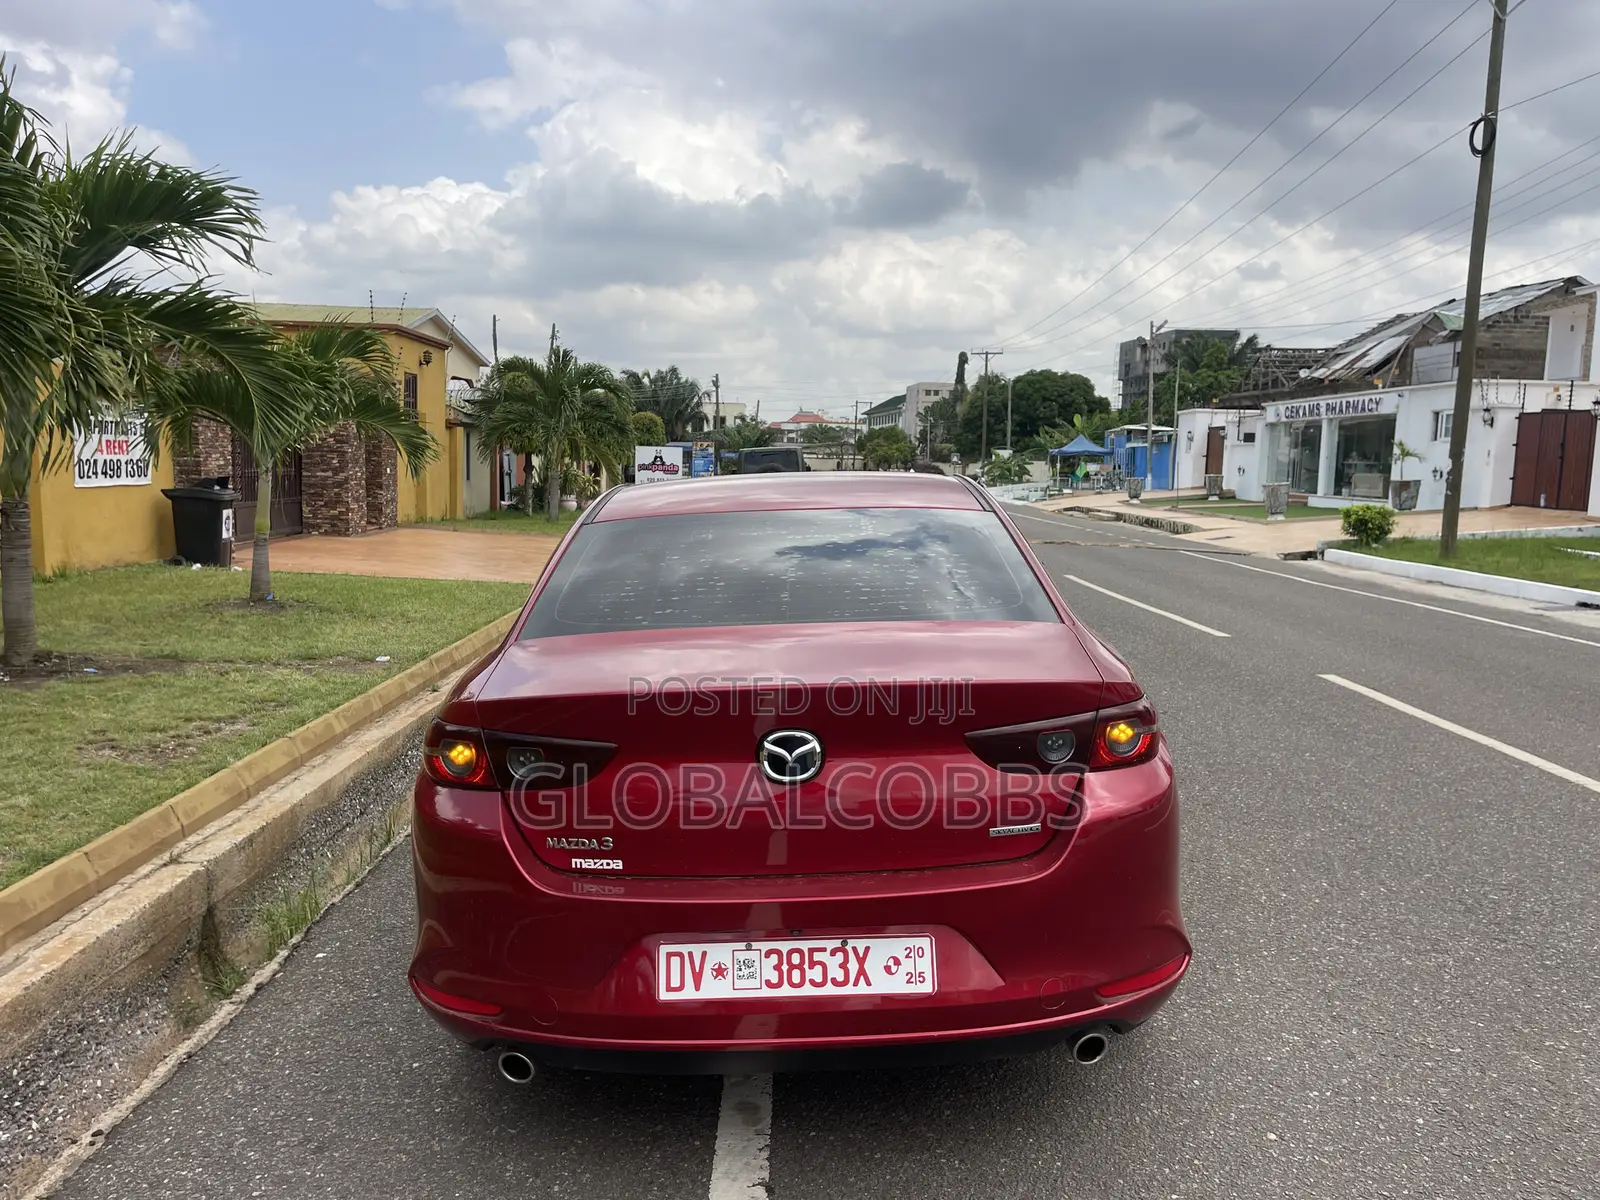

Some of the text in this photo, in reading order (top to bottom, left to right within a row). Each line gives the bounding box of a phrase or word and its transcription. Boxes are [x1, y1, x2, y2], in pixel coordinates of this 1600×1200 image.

[1325, 397, 1382, 416] PHARMACY
[105, 439, 130, 456] RENT
[78, 459, 99, 480] 024
[101, 459, 122, 479] 498
[571, 858, 623, 870] mazda
[665, 945, 873, 993] DV 3853X
